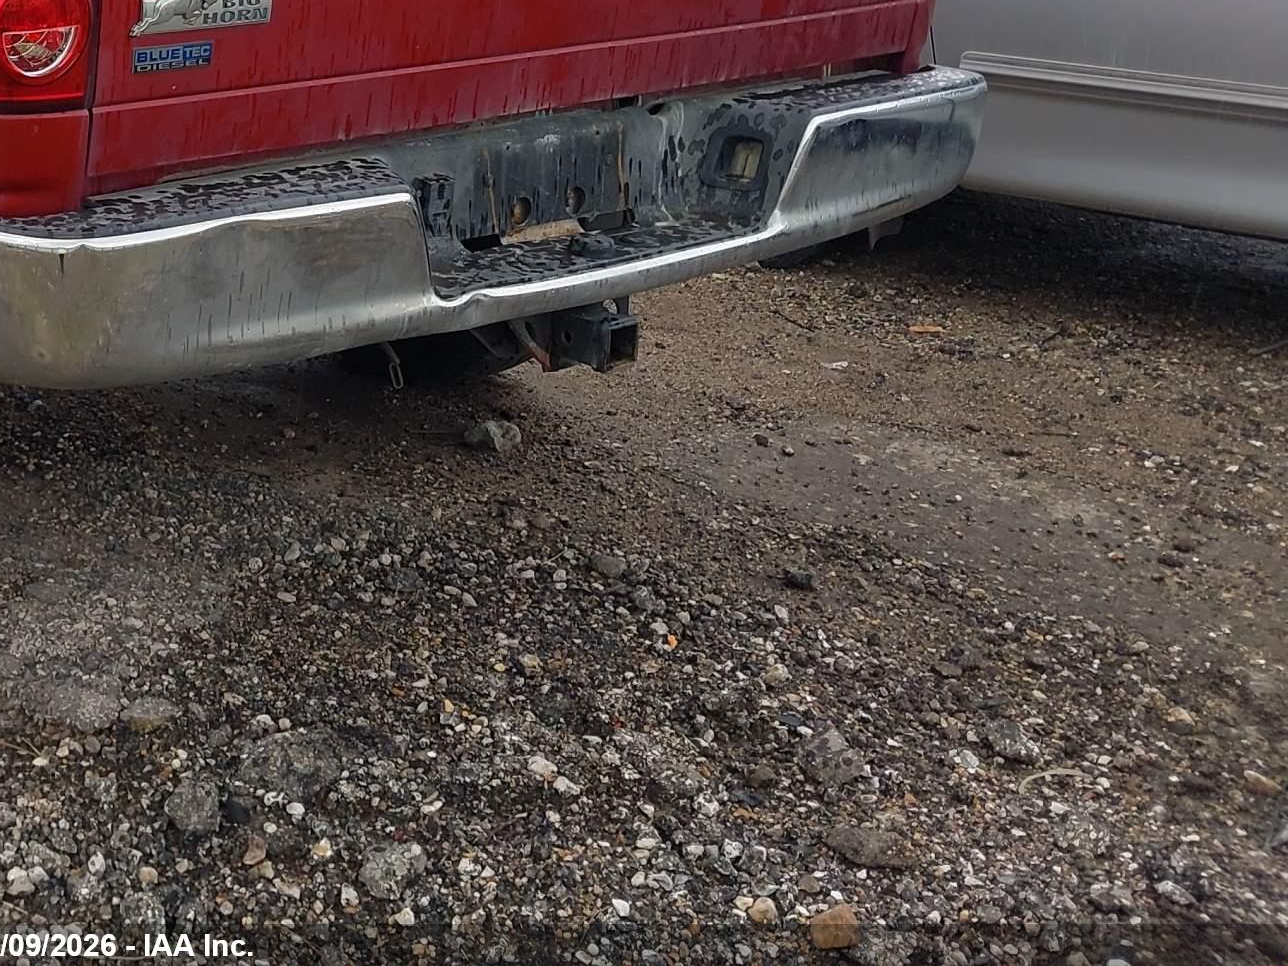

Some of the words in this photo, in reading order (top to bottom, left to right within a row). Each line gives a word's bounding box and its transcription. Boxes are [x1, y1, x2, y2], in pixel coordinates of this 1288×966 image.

[202, 7, 268, 25] HORN
[136, 44, 211, 64] BLUETEC
[135, 57, 210, 73] DIESEL
